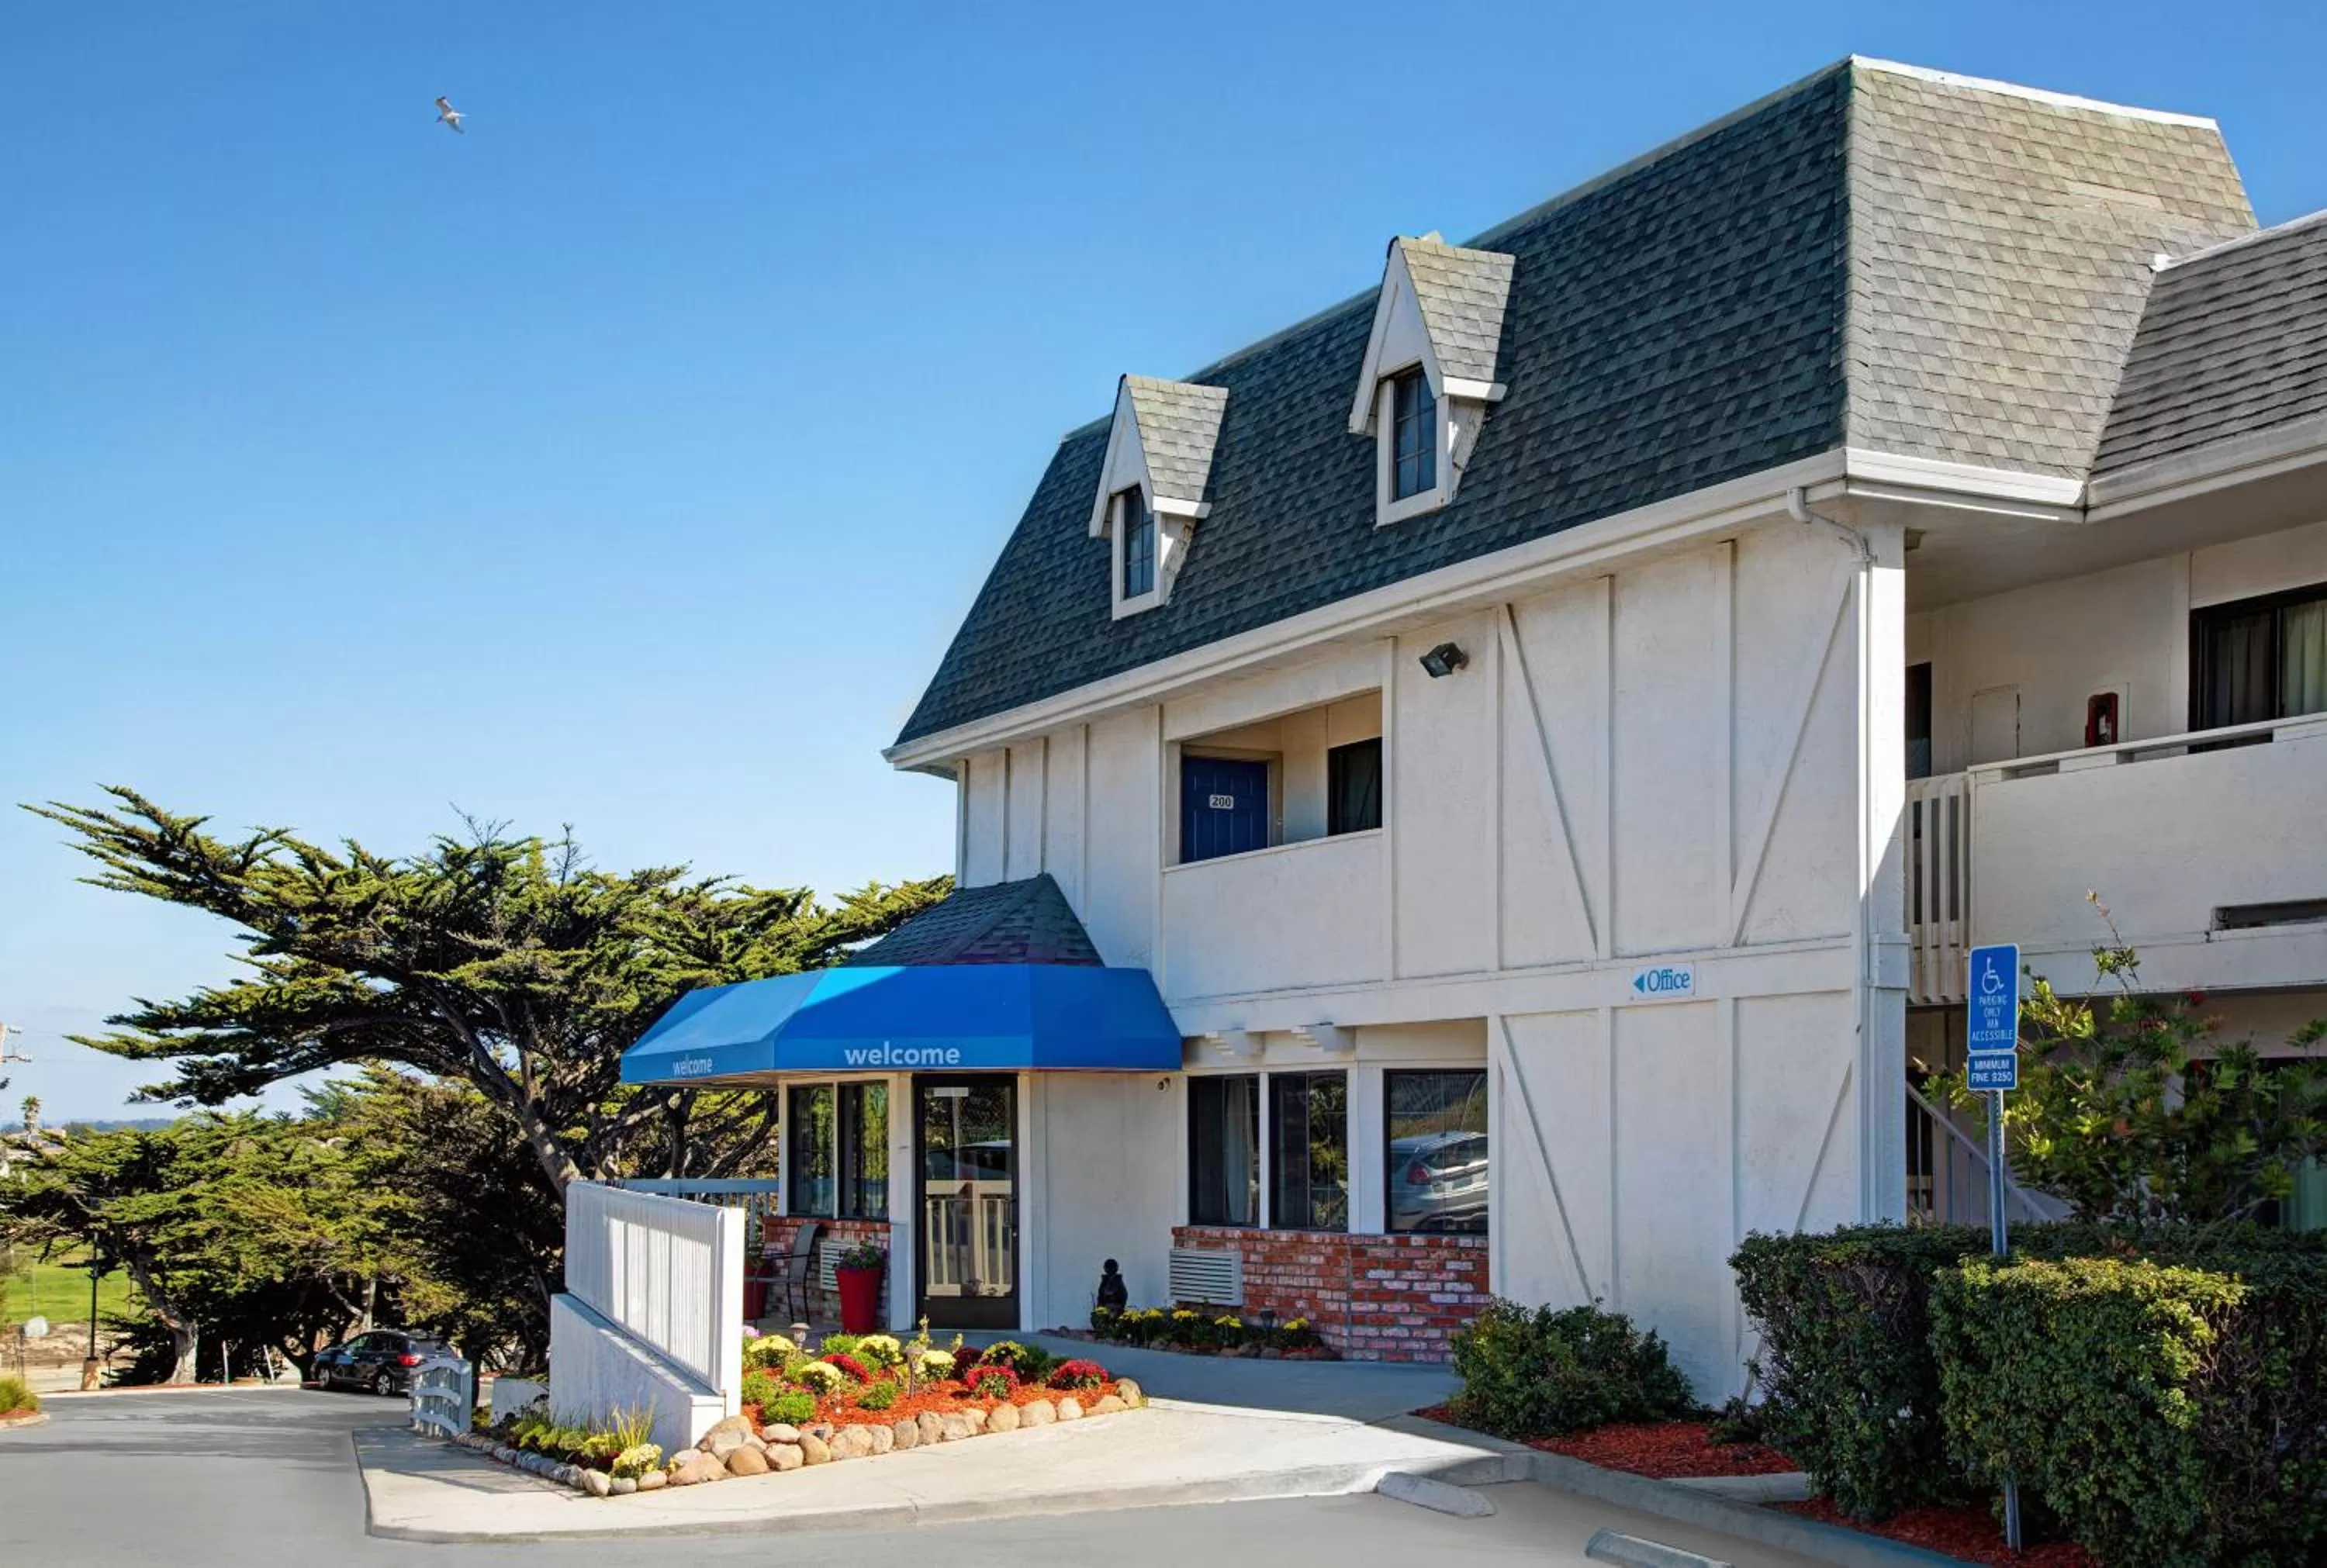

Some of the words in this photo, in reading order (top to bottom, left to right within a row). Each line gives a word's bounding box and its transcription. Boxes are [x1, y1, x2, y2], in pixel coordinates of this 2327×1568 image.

[1212, 797, 1231, 807] 200
[1647, 969, 1690, 992] Office
[1980, 995, 2007, 1006] PARKING
[1983, 1007, 2000, 1018] ONLY
[1986, 1018, 1999, 1029] VAN
[1972, 1029, 2013, 1041] ACCESSIBLE
[844, 1041, 961, 1066] welcome
[673, 1055, 713, 1077] welcome
[1974, 1059, 2010, 1070] MINIMUM
[1971, 1072, 1989, 1083] FINE
[1991, 1072, 2012, 1083] $250
